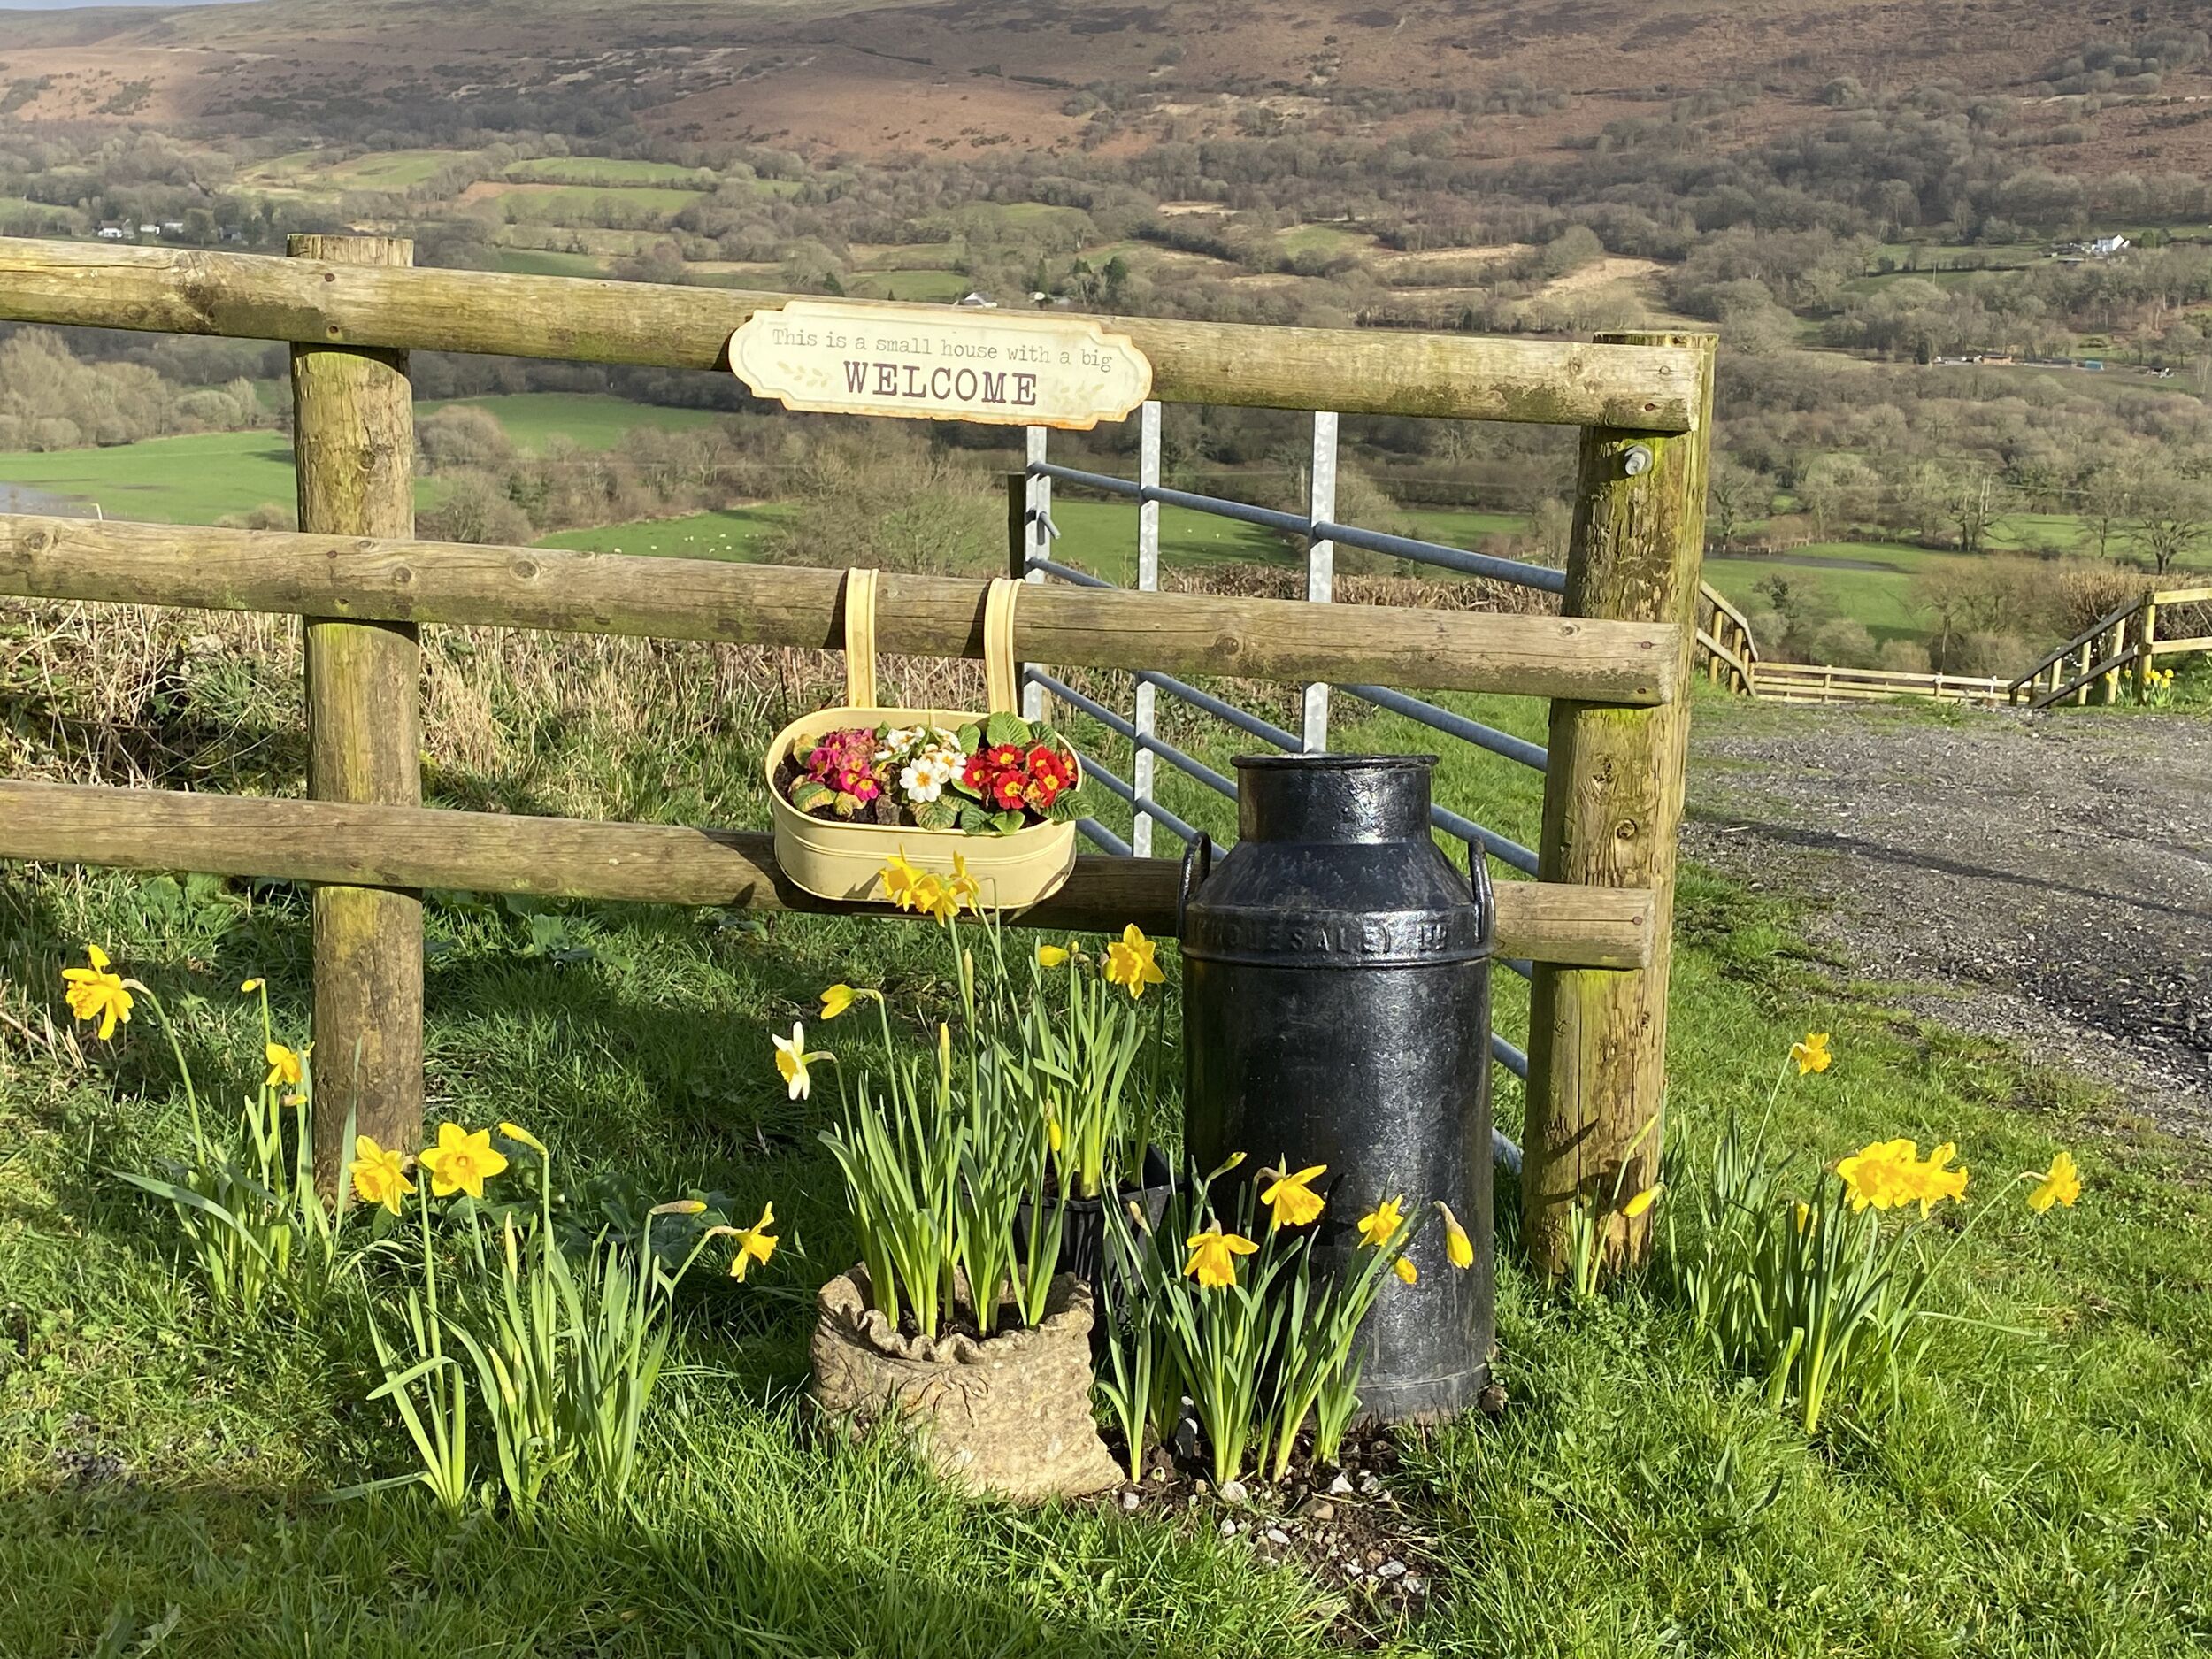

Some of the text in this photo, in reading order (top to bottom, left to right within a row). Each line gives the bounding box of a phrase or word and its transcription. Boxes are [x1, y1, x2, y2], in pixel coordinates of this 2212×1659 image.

[772, 328, 1113, 373] This is a small house with a big
[843, 360, 1037, 406] WELCOME
